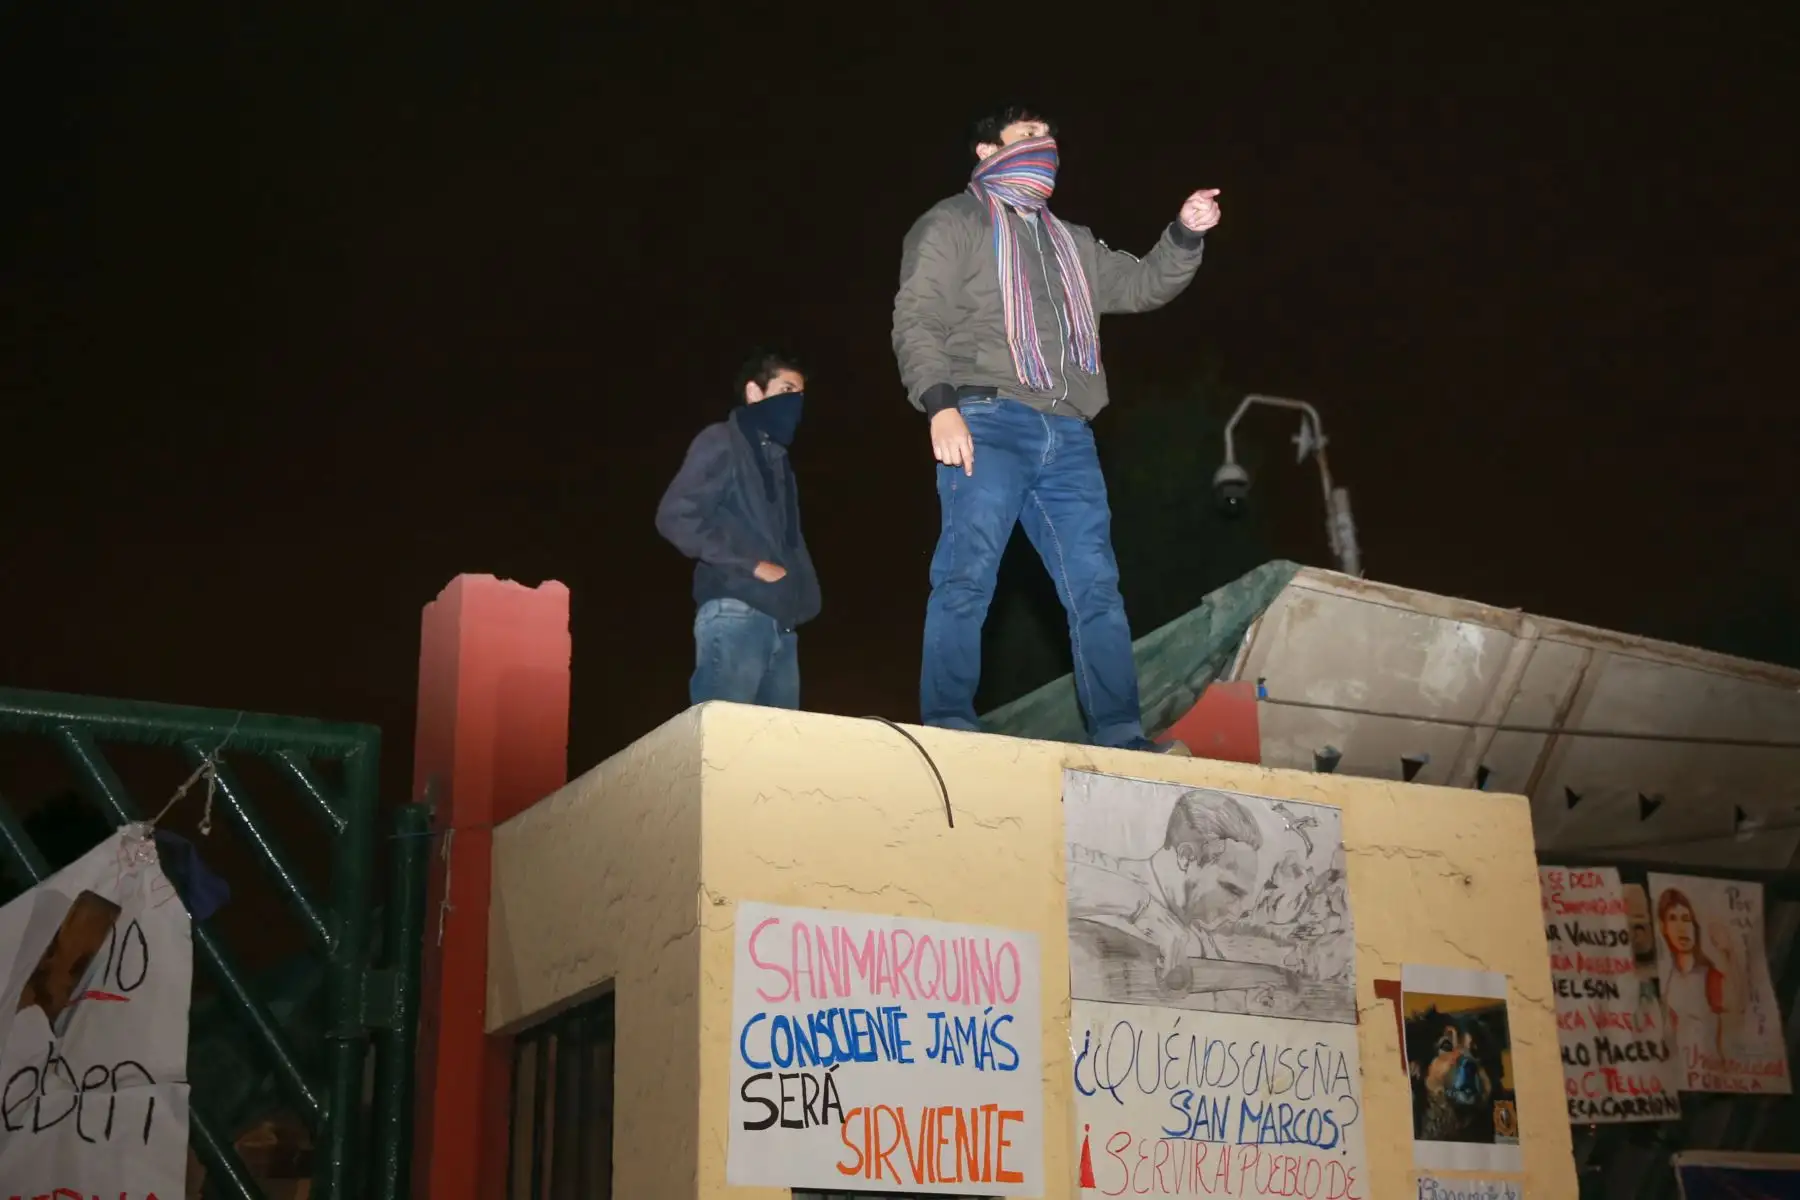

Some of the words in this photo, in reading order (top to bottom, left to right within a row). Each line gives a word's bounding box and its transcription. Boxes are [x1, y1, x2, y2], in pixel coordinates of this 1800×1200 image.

[749, 917, 1021, 1005] SANMARQUINO
[1564, 921, 1630, 947] VALLEJO
[926, 1006, 1020, 1071] JAMÁS
[1186, 1034, 1240, 1089] NOS
[1242, 1041, 1352, 1101] ENSEÑA
[740, 1063, 846, 1131] SERÁ
[1599, 1066, 1663, 1096] TELLO
[836, 1103, 1025, 1185] SIRVIENTE
[1161, 1088, 1231, 1143] SAN
[1237, 1094, 1360, 1156] MARCOS?
[1324, 1159, 1362, 1200] DE
